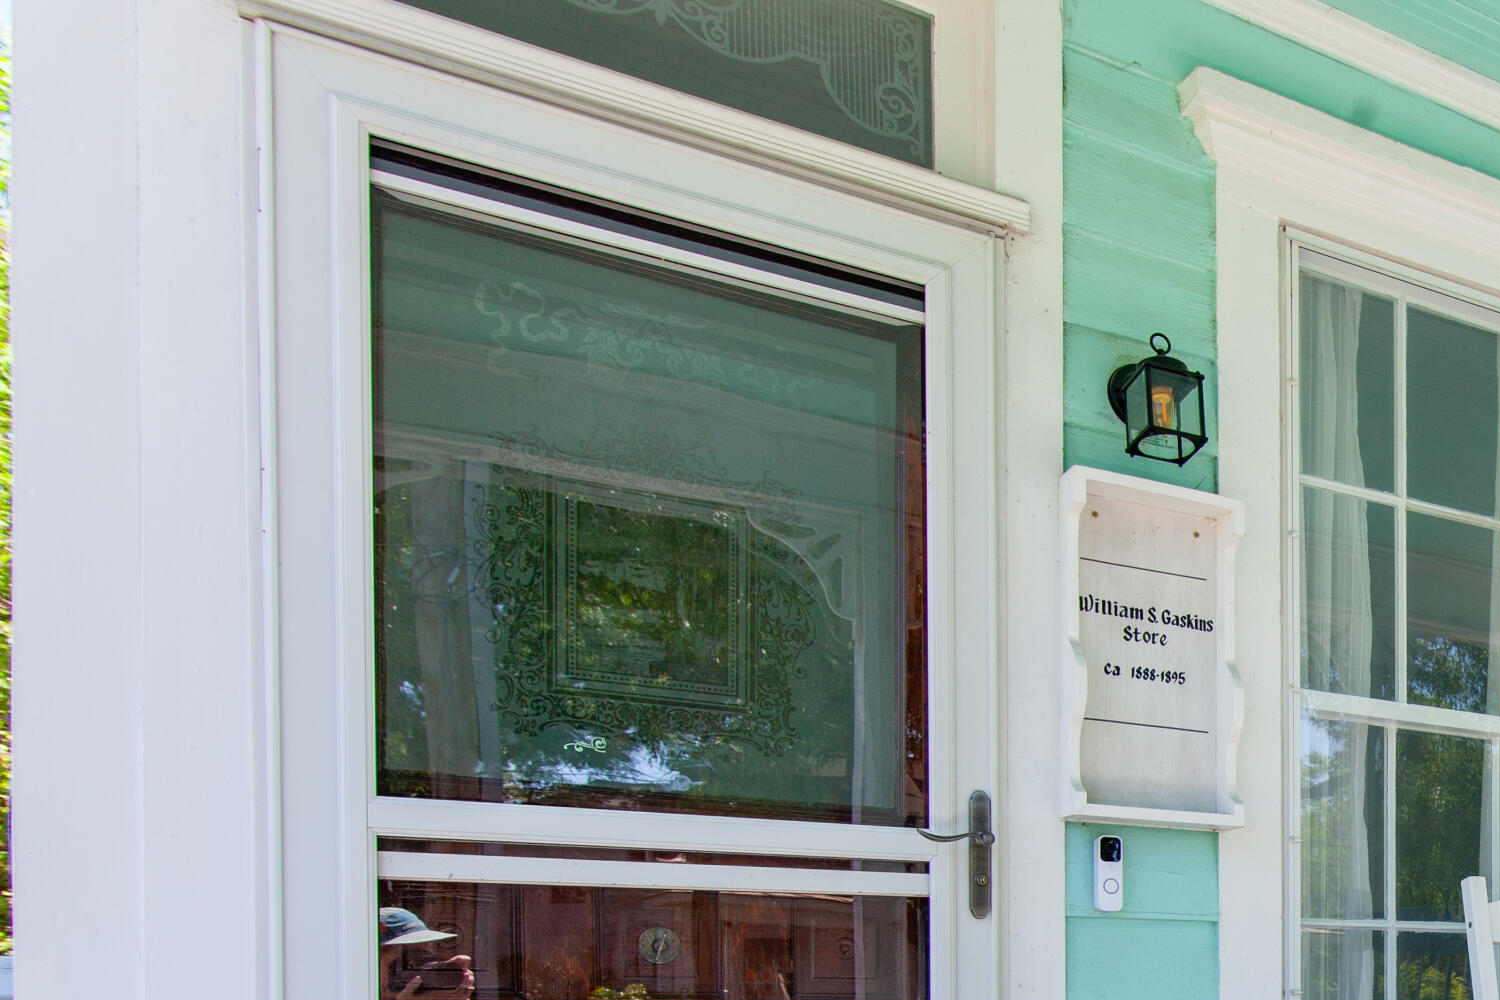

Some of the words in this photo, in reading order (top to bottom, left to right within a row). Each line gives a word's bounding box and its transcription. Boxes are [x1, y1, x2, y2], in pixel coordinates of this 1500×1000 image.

[1079, 594, 1144, 621] William
[1147, 607, 1158, 624] S.
[1161, 609, 1214, 632] Gaskins
[1123, 625, 1168, 646] Store
[1103, 662, 1121, 676] ca
[1131, 666, 1186, 685] 1888-1895
